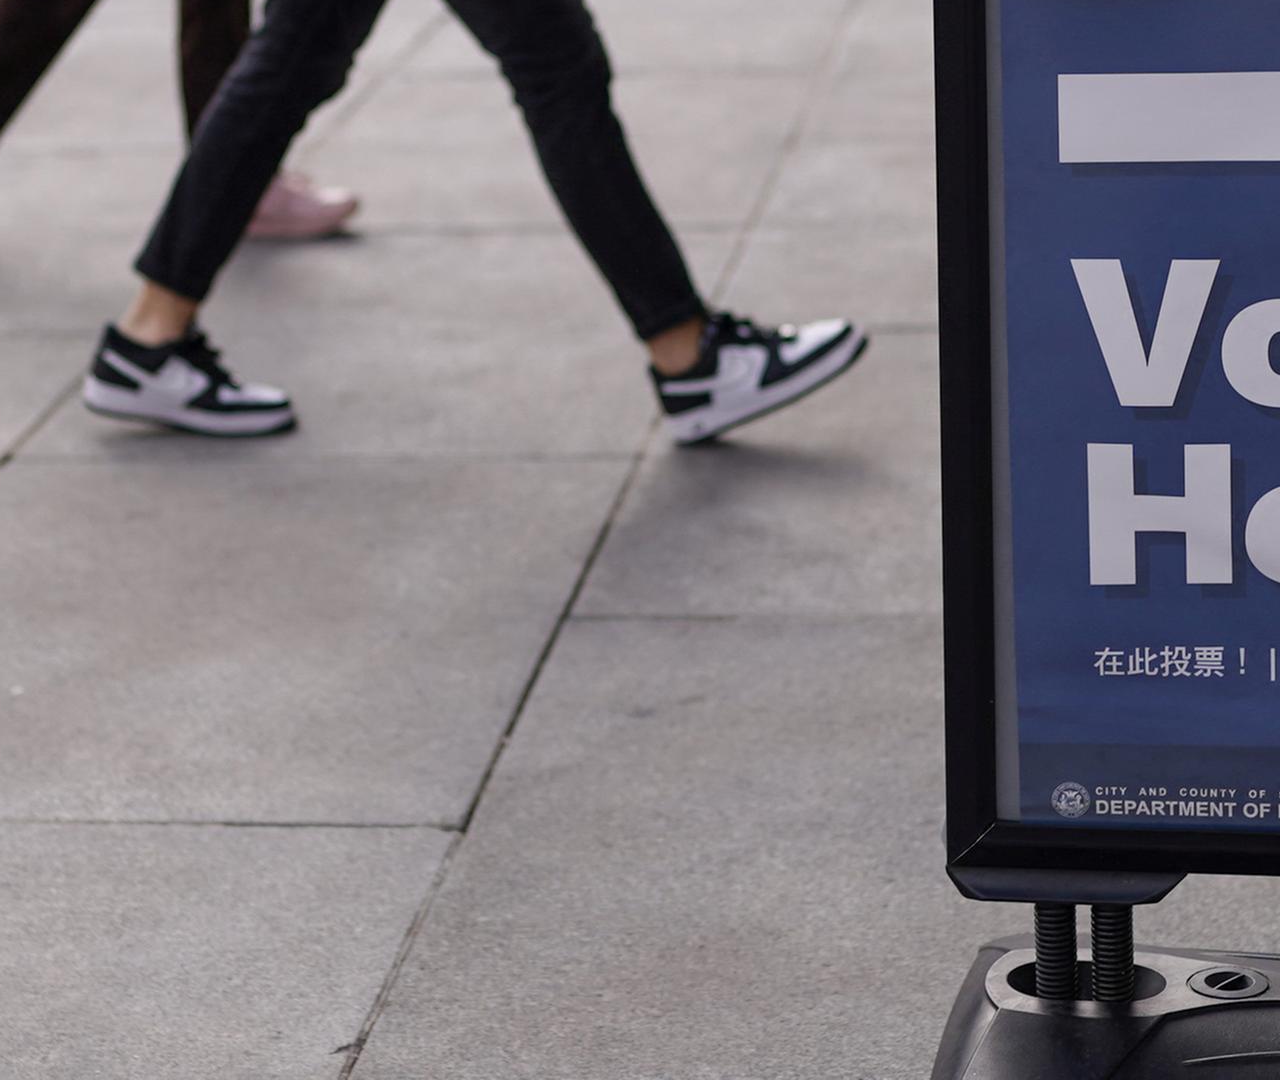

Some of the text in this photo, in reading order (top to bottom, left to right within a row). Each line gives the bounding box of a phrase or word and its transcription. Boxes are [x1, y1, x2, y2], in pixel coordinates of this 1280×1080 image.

[1095, 786, 1127, 796] CITY
[1138, 787, 1167, 797] AND
[1179, 787, 1237, 798] COUNTY
[1248, 789, 1266, 799] OF
[1095, 799, 1237, 818] DEPARTMENT
[1242, 802, 1271, 819] OF
